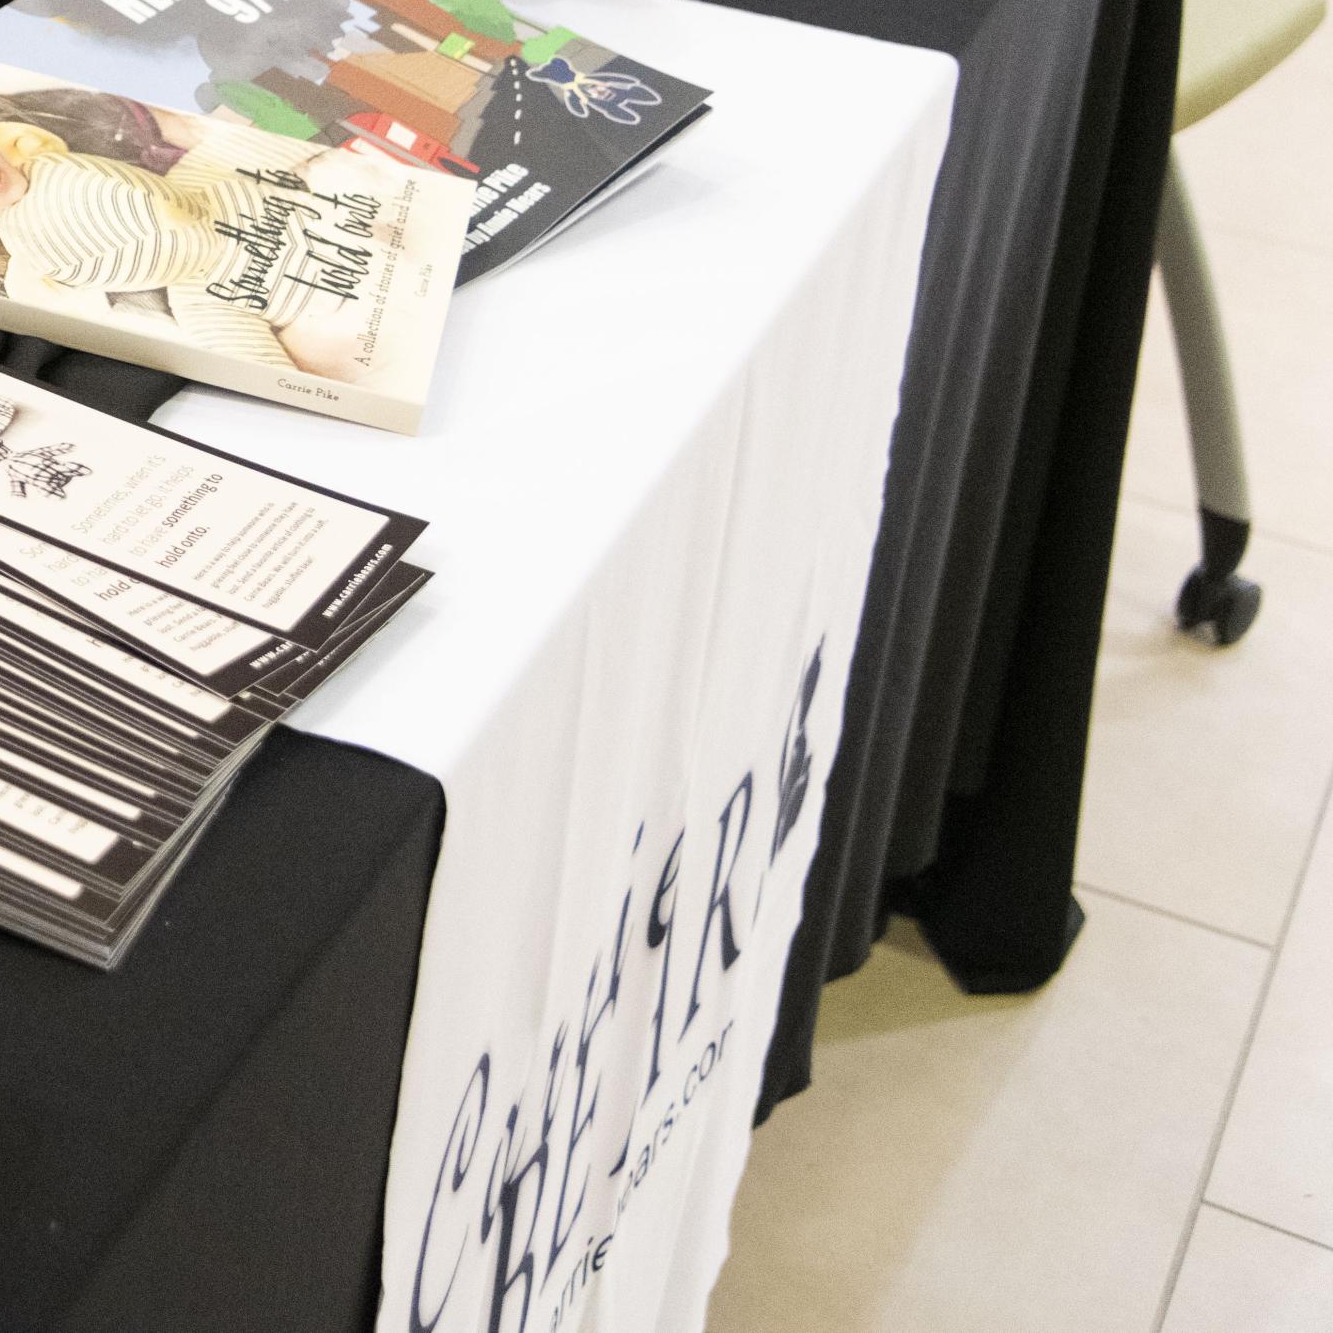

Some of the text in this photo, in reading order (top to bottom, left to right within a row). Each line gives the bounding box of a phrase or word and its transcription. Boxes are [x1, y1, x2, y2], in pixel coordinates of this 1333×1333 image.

[482, 163, 529, 193] Pike
[206, 168, 322, 310] Something to
[353, 178, 420, 367] A collection of stories of grief and hope
[277, 378, 340, 401] Carrie Pike
[161, 479, 217, 528] something
[206, 473, 223, 486] to
[155, 525, 211, 569] hold onto.
[93, 579, 131, 602] hold
[322, 543, 394, 620] www.carriebears.com
